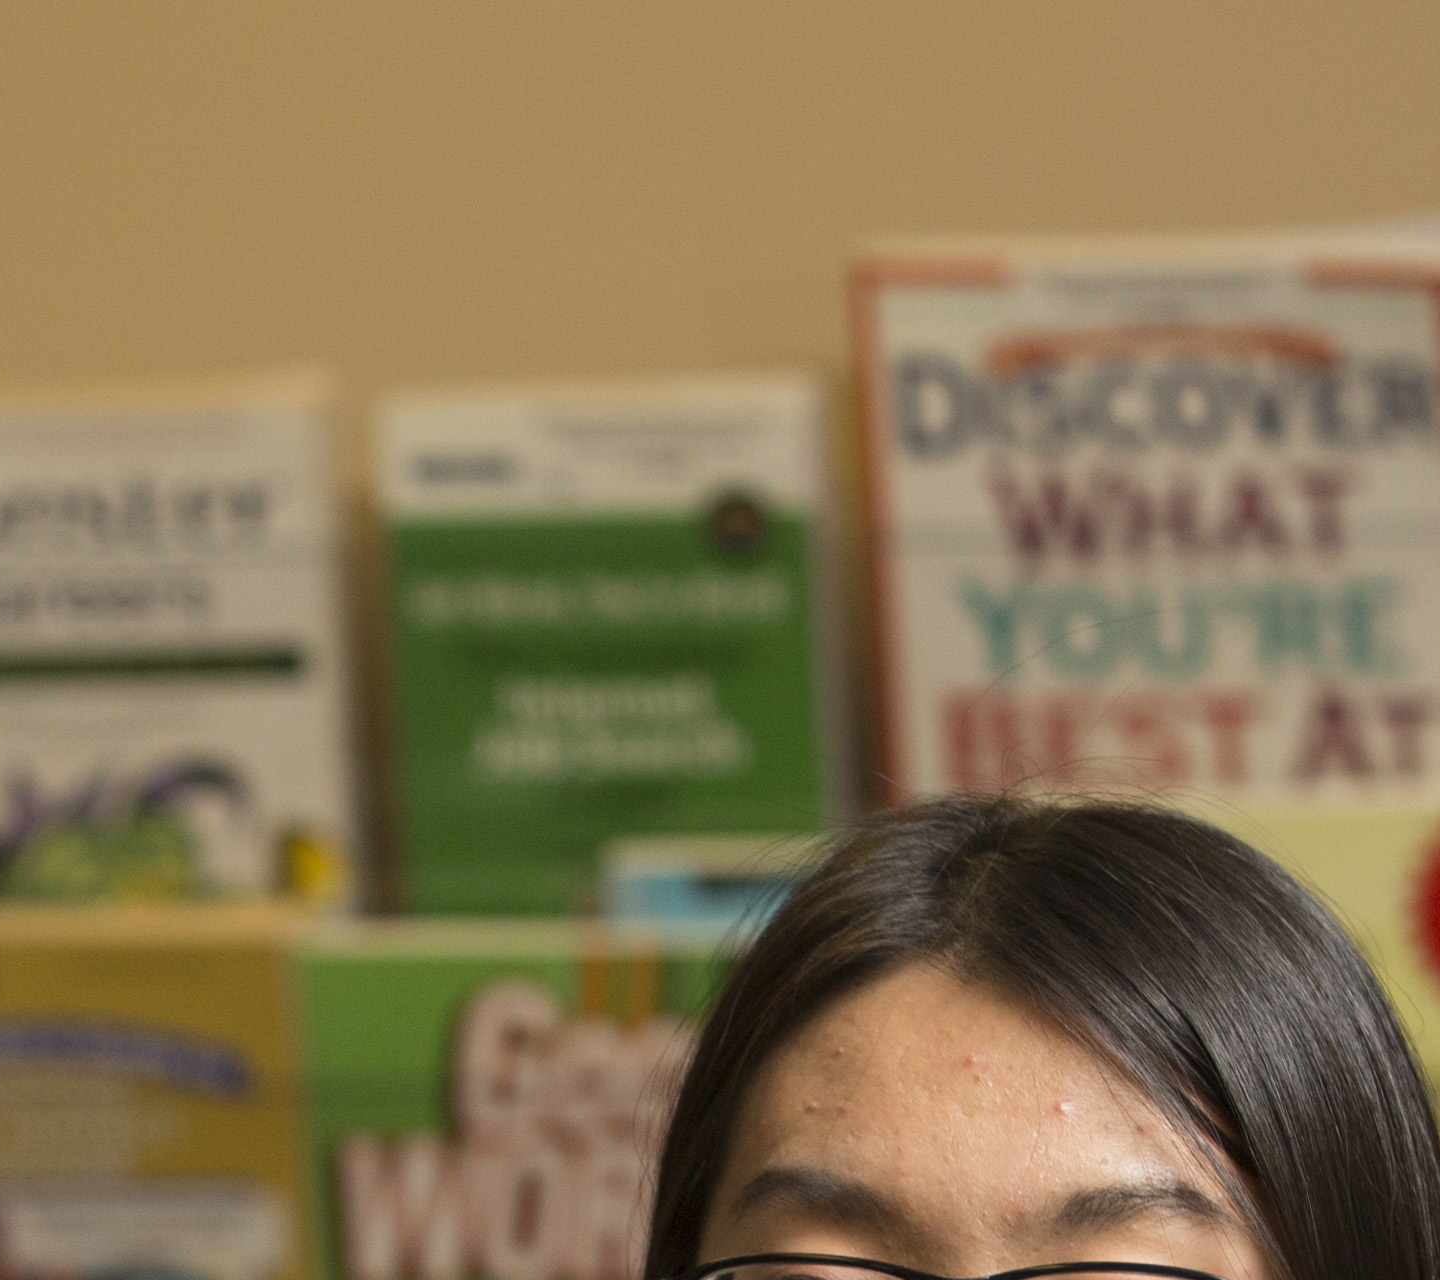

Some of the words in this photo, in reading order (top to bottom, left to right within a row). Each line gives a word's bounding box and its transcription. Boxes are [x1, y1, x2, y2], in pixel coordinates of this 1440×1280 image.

[986, 463, 1358, 568] WHAT
[956, 575, 1412, 680] YOU'RE
[940, 690, 1260, 788] BEST
[1294, 690, 1434, 785] AT
